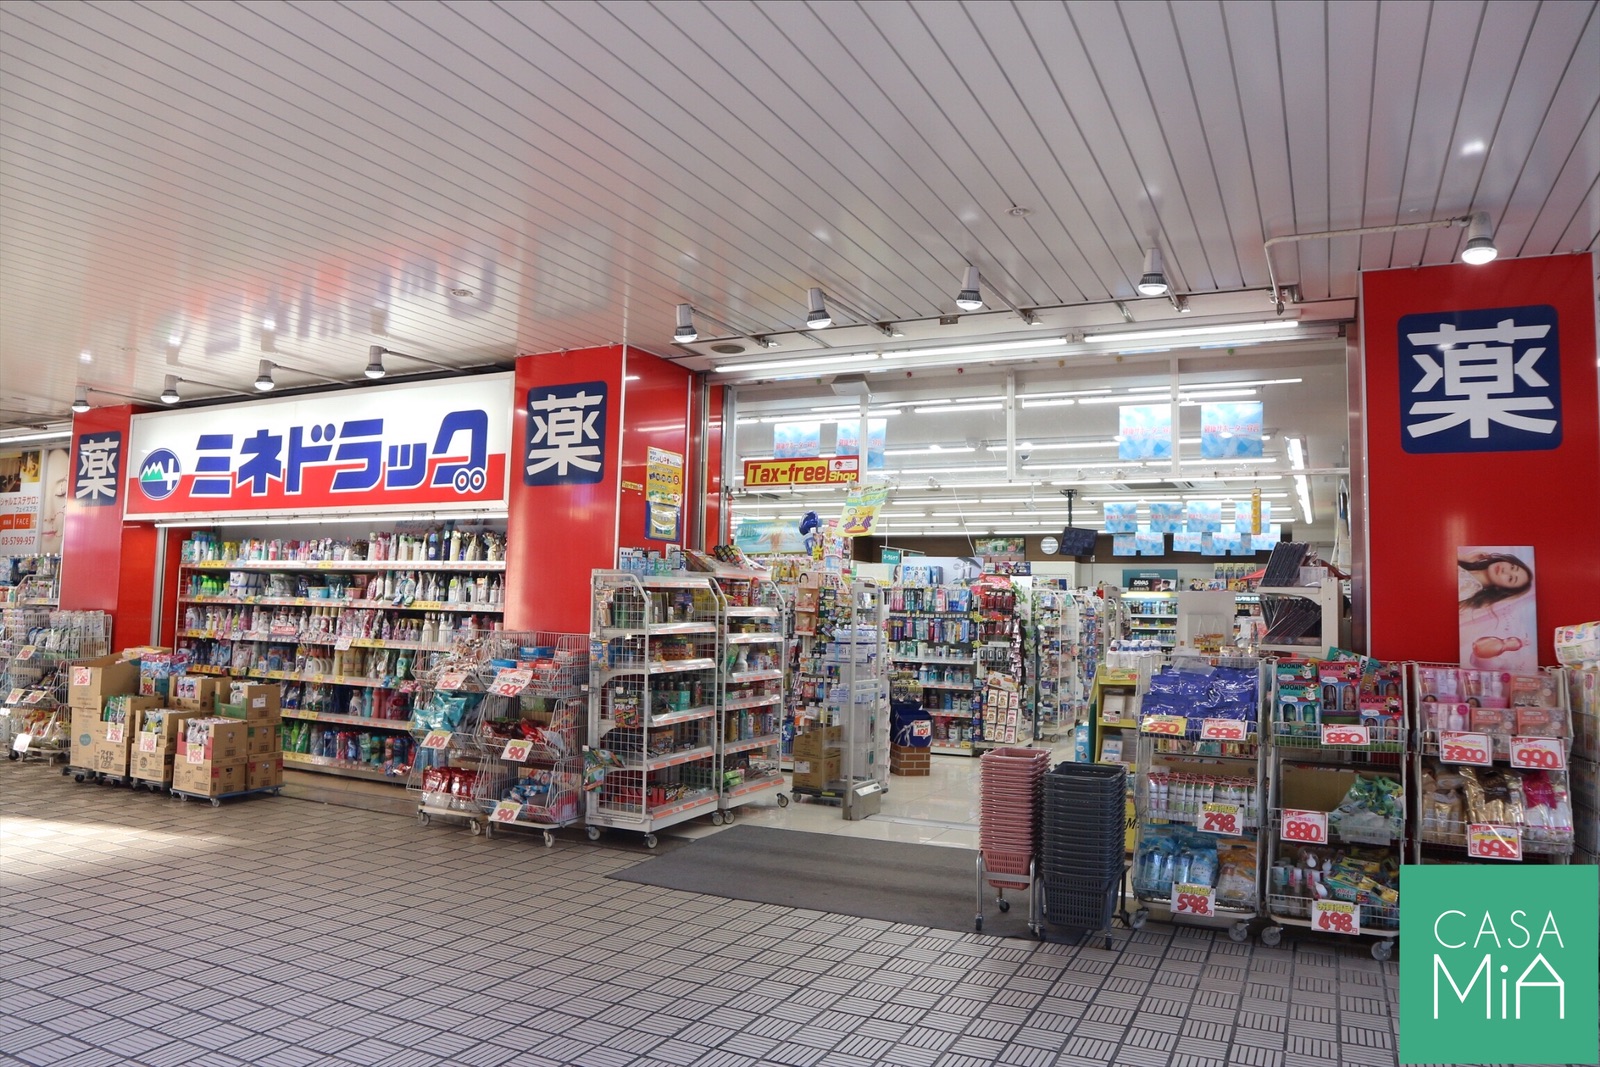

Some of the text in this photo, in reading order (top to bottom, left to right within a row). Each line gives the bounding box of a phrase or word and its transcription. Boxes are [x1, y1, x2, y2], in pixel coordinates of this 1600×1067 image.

[1406, 318, 1558, 439] 薬
[525, 390, 604, 476] 薬
[75, 437, 121, 500] 薬
[749, 463, 826, 483] Tax-free
[828, 471, 857, 483] Shop
[16, 517, 29, 525] FACE
[425, 735, 446, 747] 100
[1325, 732, 1364, 744] 880
[508, 746, 526, 759] 90
[1516, 749, 1559, 768] 990
[497, 808, 515, 821] 90
[1203, 812, 1236, 832] 298
[1286, 820, 1322, 842] 880
[1177, 893, 1209, 914] 598
